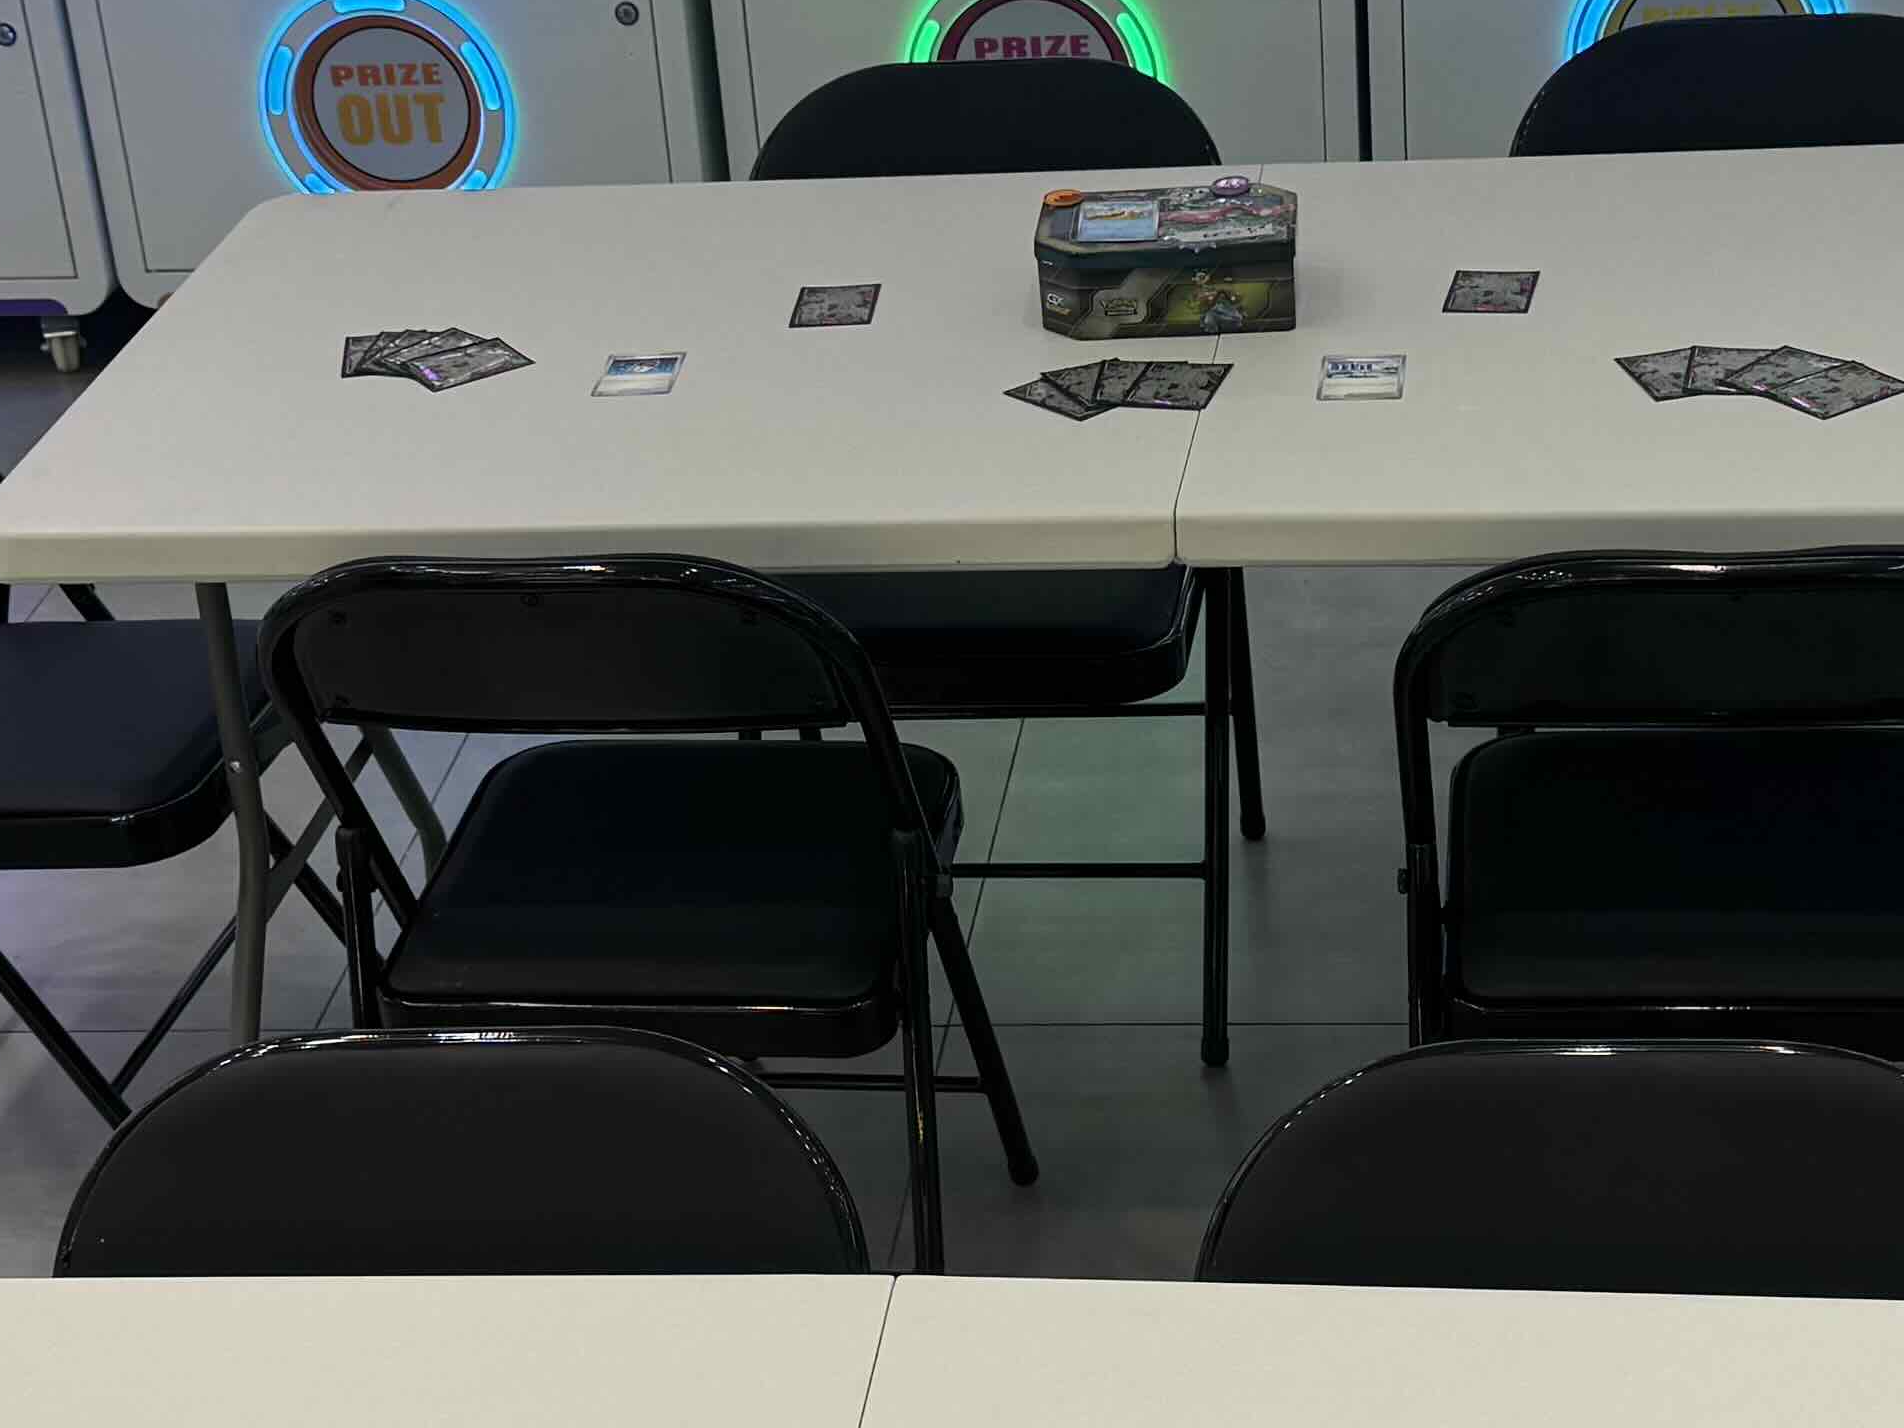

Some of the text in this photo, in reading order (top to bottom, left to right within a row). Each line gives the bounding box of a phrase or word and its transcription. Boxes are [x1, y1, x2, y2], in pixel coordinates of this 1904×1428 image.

[974, 34, 1091, 60] PRIZE
[330, 63, 443, 86] PRIZE
[337, 94, 446, 146] OUT
